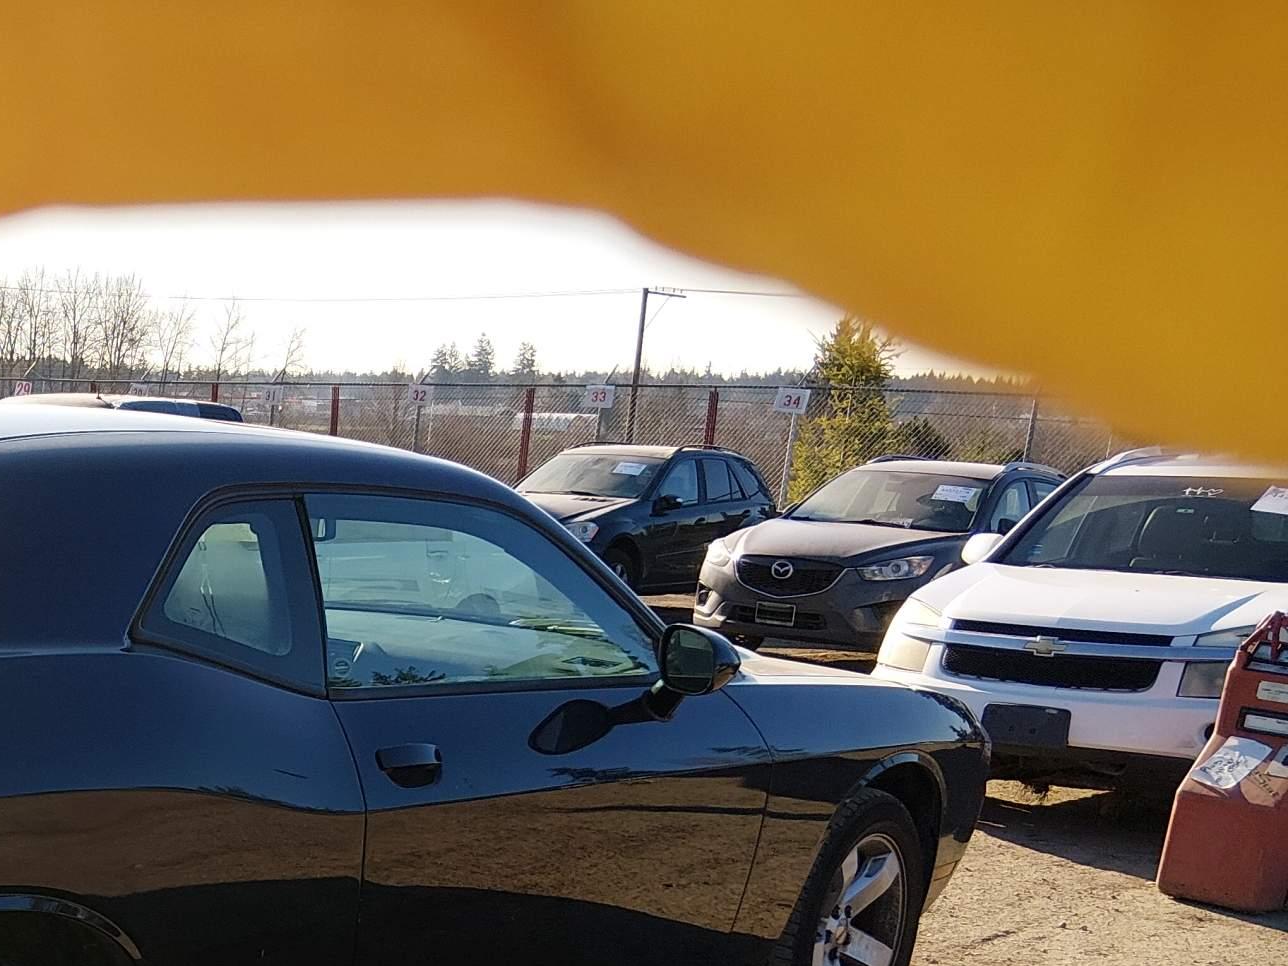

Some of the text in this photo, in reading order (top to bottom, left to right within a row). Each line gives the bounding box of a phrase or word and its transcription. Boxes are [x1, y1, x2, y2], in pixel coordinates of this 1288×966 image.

[16, 382, 30, 395] 29
[265, 389, 276, 401] 31
[412, 390, 426, 402] 32
[591, 391, 607, 402] 33
[783, 395, 801, 408] 34
